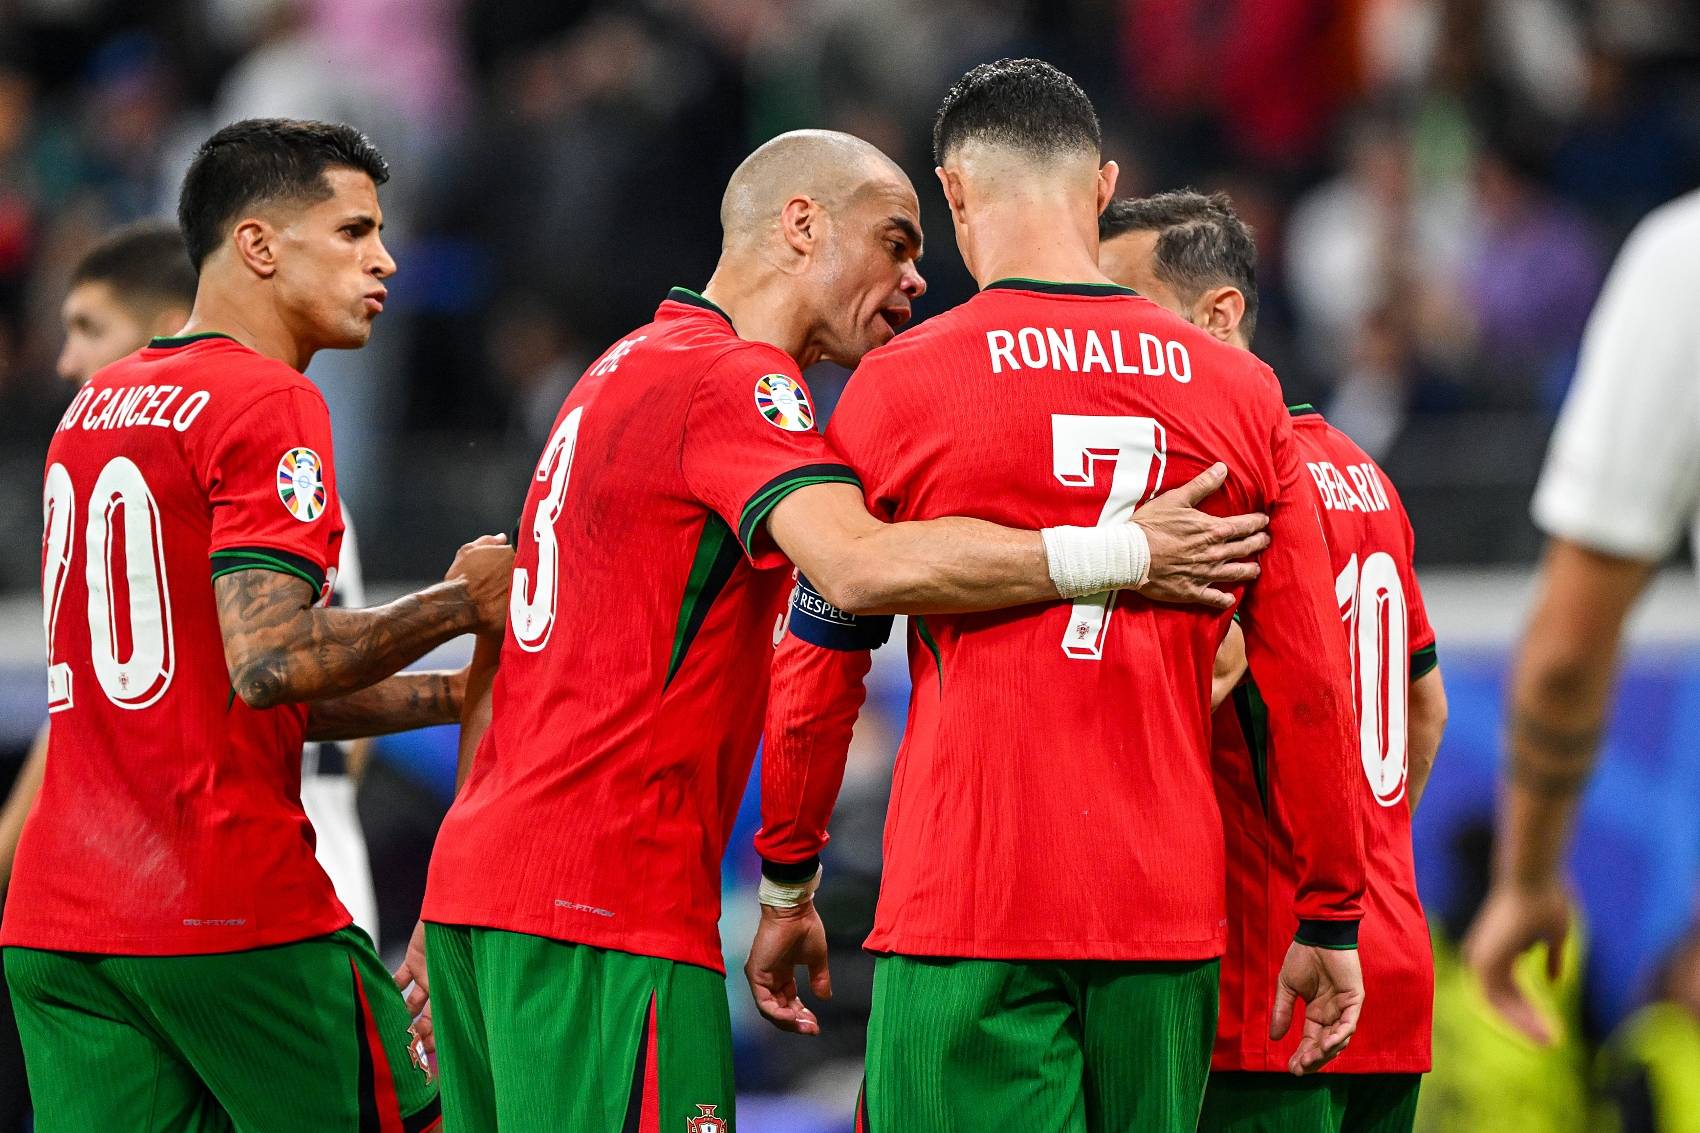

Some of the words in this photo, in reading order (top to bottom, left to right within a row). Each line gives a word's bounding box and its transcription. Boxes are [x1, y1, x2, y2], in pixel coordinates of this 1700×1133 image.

[82, 384, 211, 432] CANCELO
[986, 327, 1192, 384] RONALDO
[44, 456, 175, 711] 20
[510, 406, 583, 653] 3
[1052, 413, 1167, 660] 7
[1335, 552, 1408, 808] 10
